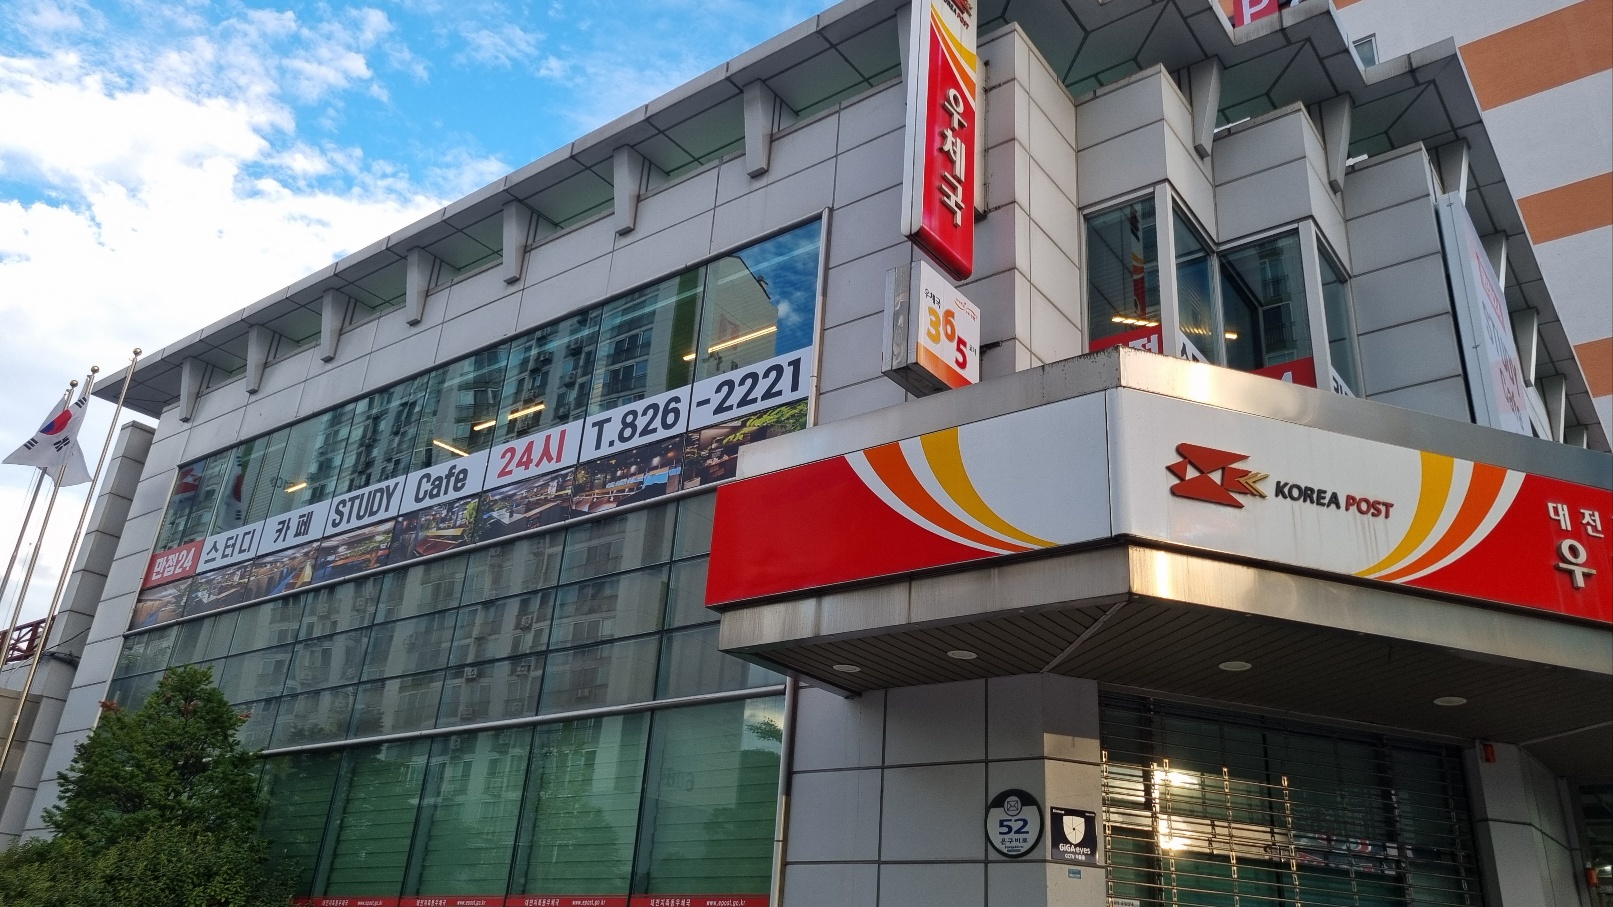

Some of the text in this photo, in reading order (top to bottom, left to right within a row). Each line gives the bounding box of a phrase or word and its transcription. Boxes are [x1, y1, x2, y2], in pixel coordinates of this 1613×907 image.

[938, 88, 967, 228] 우체국
[926, 306, 968, 370] 365
[152, 547, 196, 580] 만점24
[204, 529, 256, 565] 스터디
[273, 511, 314, 544] 카페
[331, 482, 399, 529] STUDY
[414, 464, 468, 503] Cafe
[496, 429, 567, 479] 24시
[1275, 480, 1394, 519] KOREA POST
[1547, 502, 1613, 538] 대전
[998, 817, 1029, 835] 52
